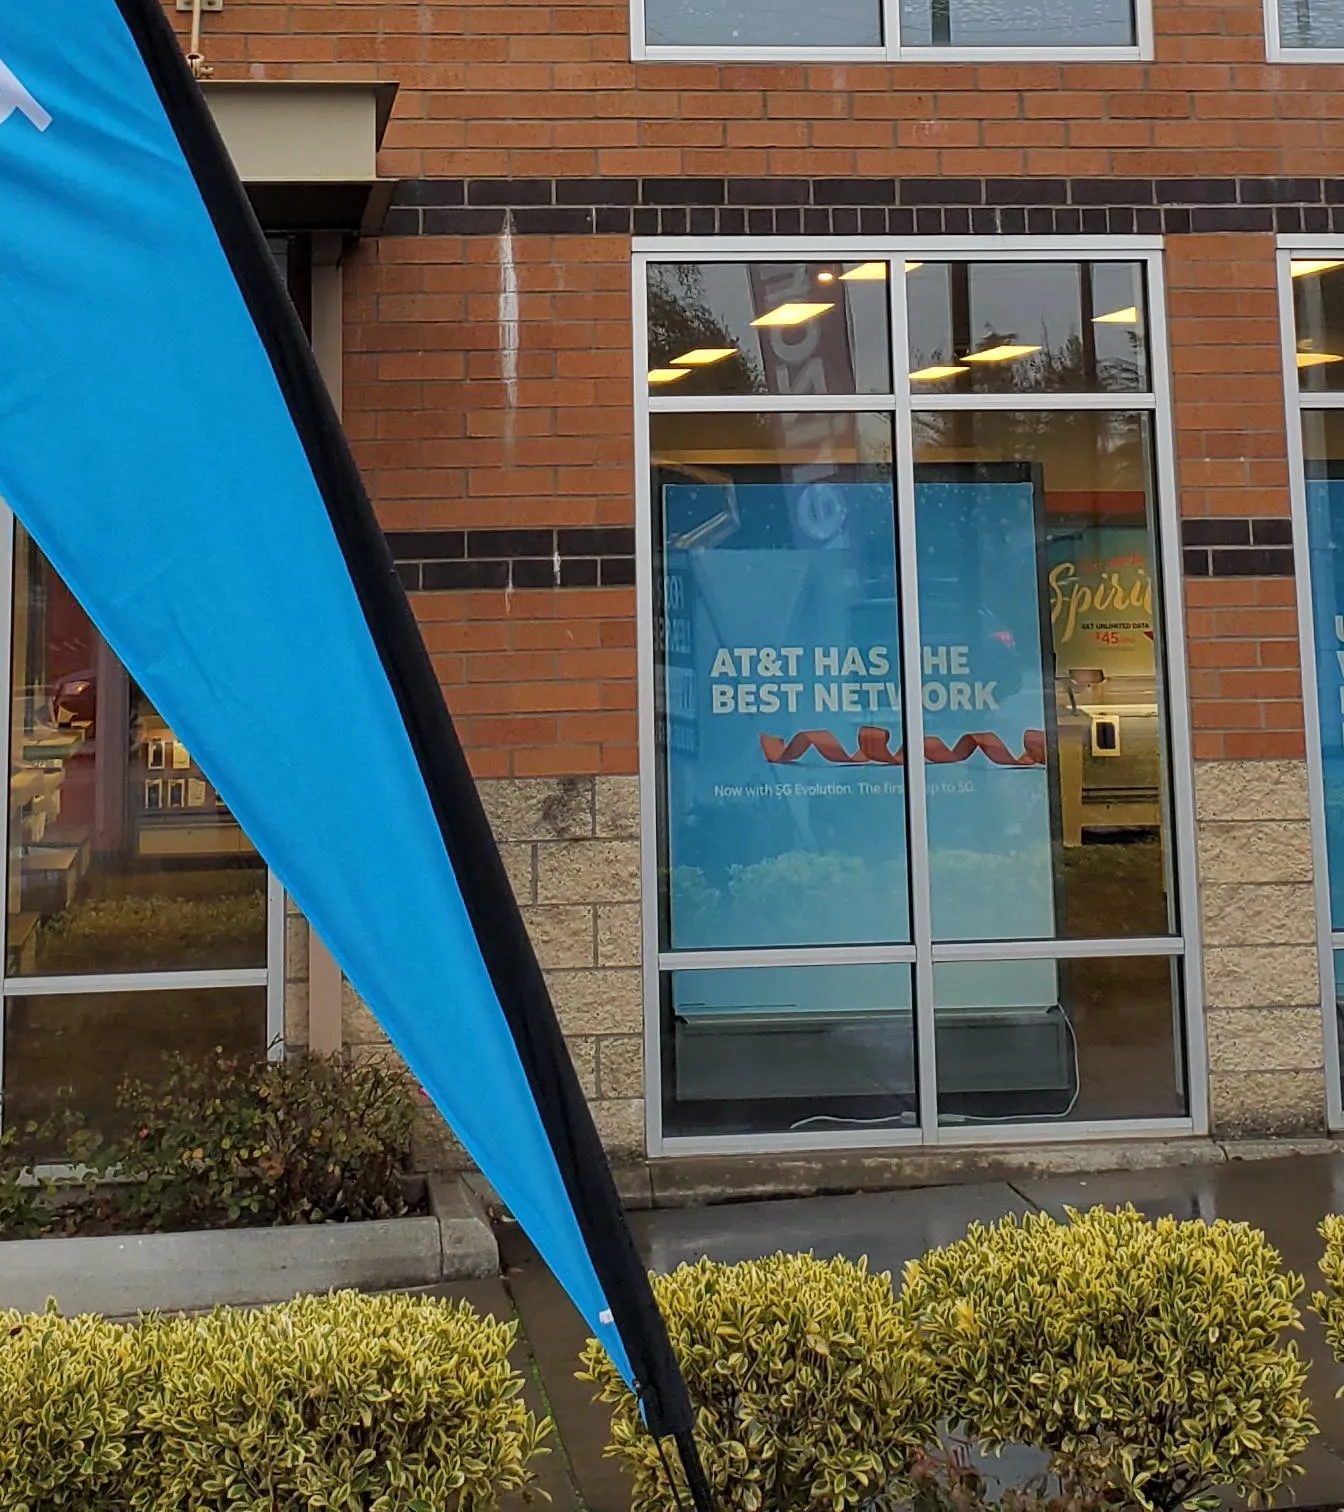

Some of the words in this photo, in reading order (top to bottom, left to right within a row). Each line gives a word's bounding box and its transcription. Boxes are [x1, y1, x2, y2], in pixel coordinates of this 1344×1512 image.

[710, 646, 804, 677] AT&T
[815, 646, 890, 677] HAS
[922, 645, 971, 676] HE
[712, 683, 804, 714] BEST
[713, 784, 743, 797] Now
[745, 783, 773, 796] with
[775, 783, 792, 796] 5G
[857, 781, 881, 795] The
[883, 780, 904, 794] firs
